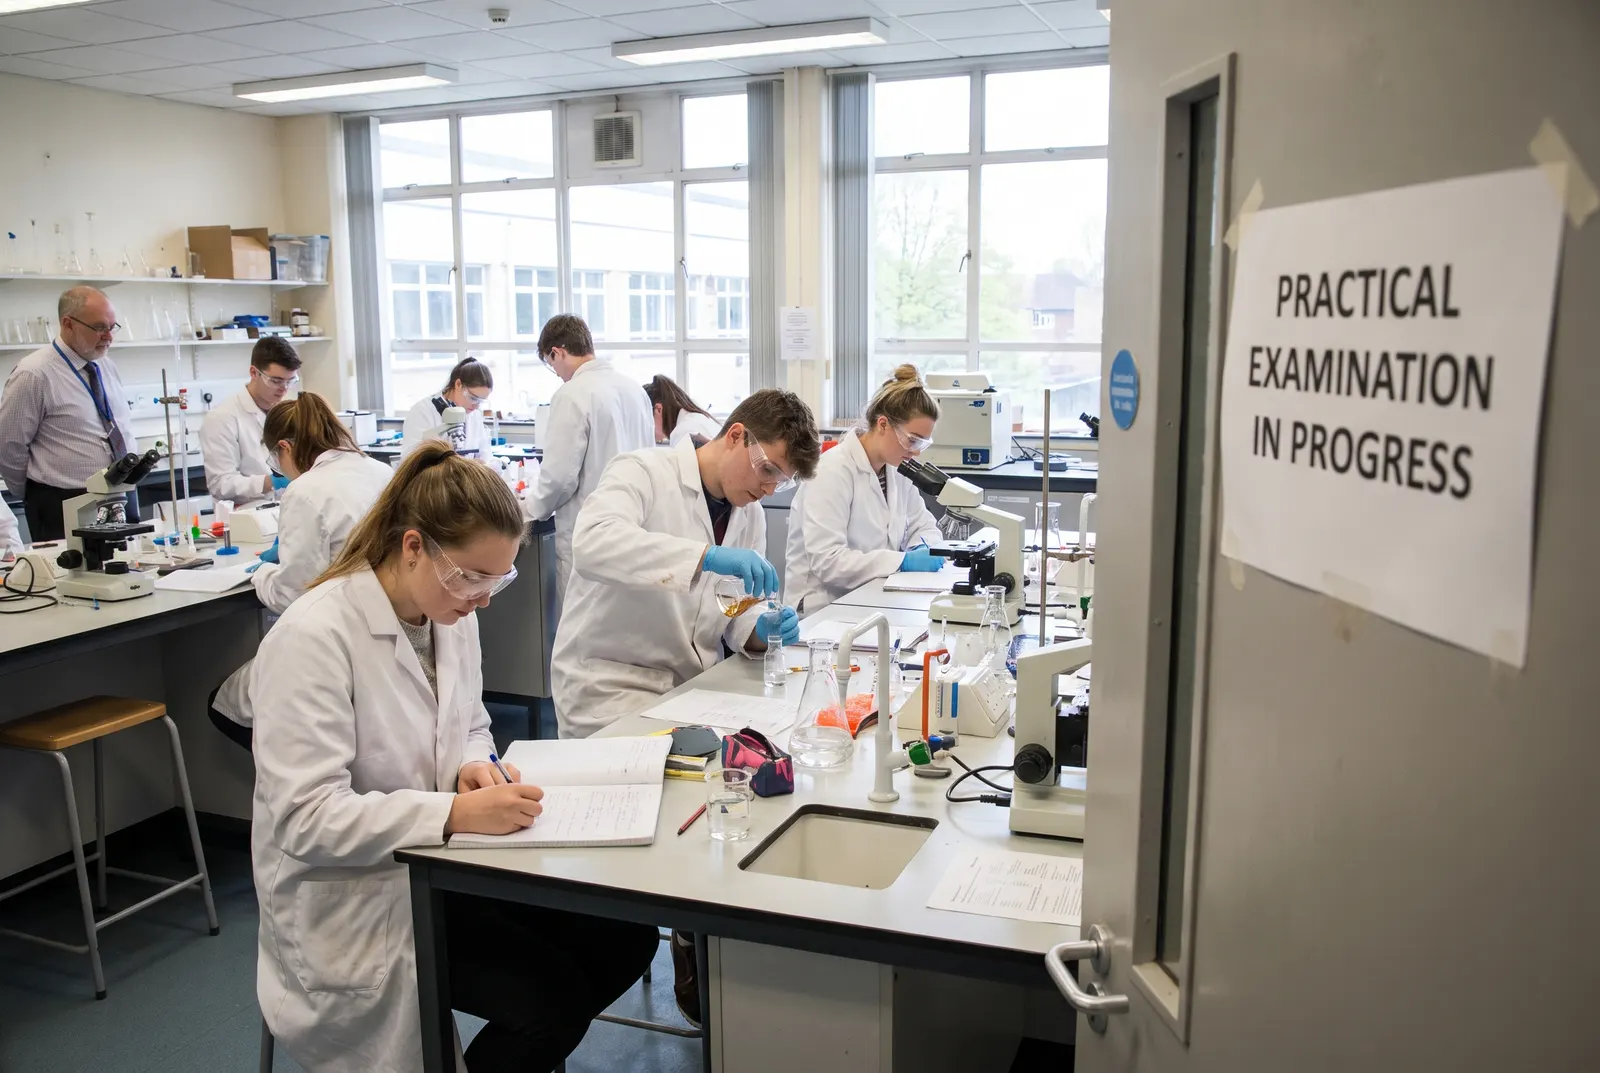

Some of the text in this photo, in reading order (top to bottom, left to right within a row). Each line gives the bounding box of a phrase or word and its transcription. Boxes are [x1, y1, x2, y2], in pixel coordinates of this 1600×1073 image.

[1277, 264, 1461, 319] PRACTICAL
[1248, 346, 1495, 411] EXAMINATION
[1253, 415, 1474, 500] IN PROGRESS
